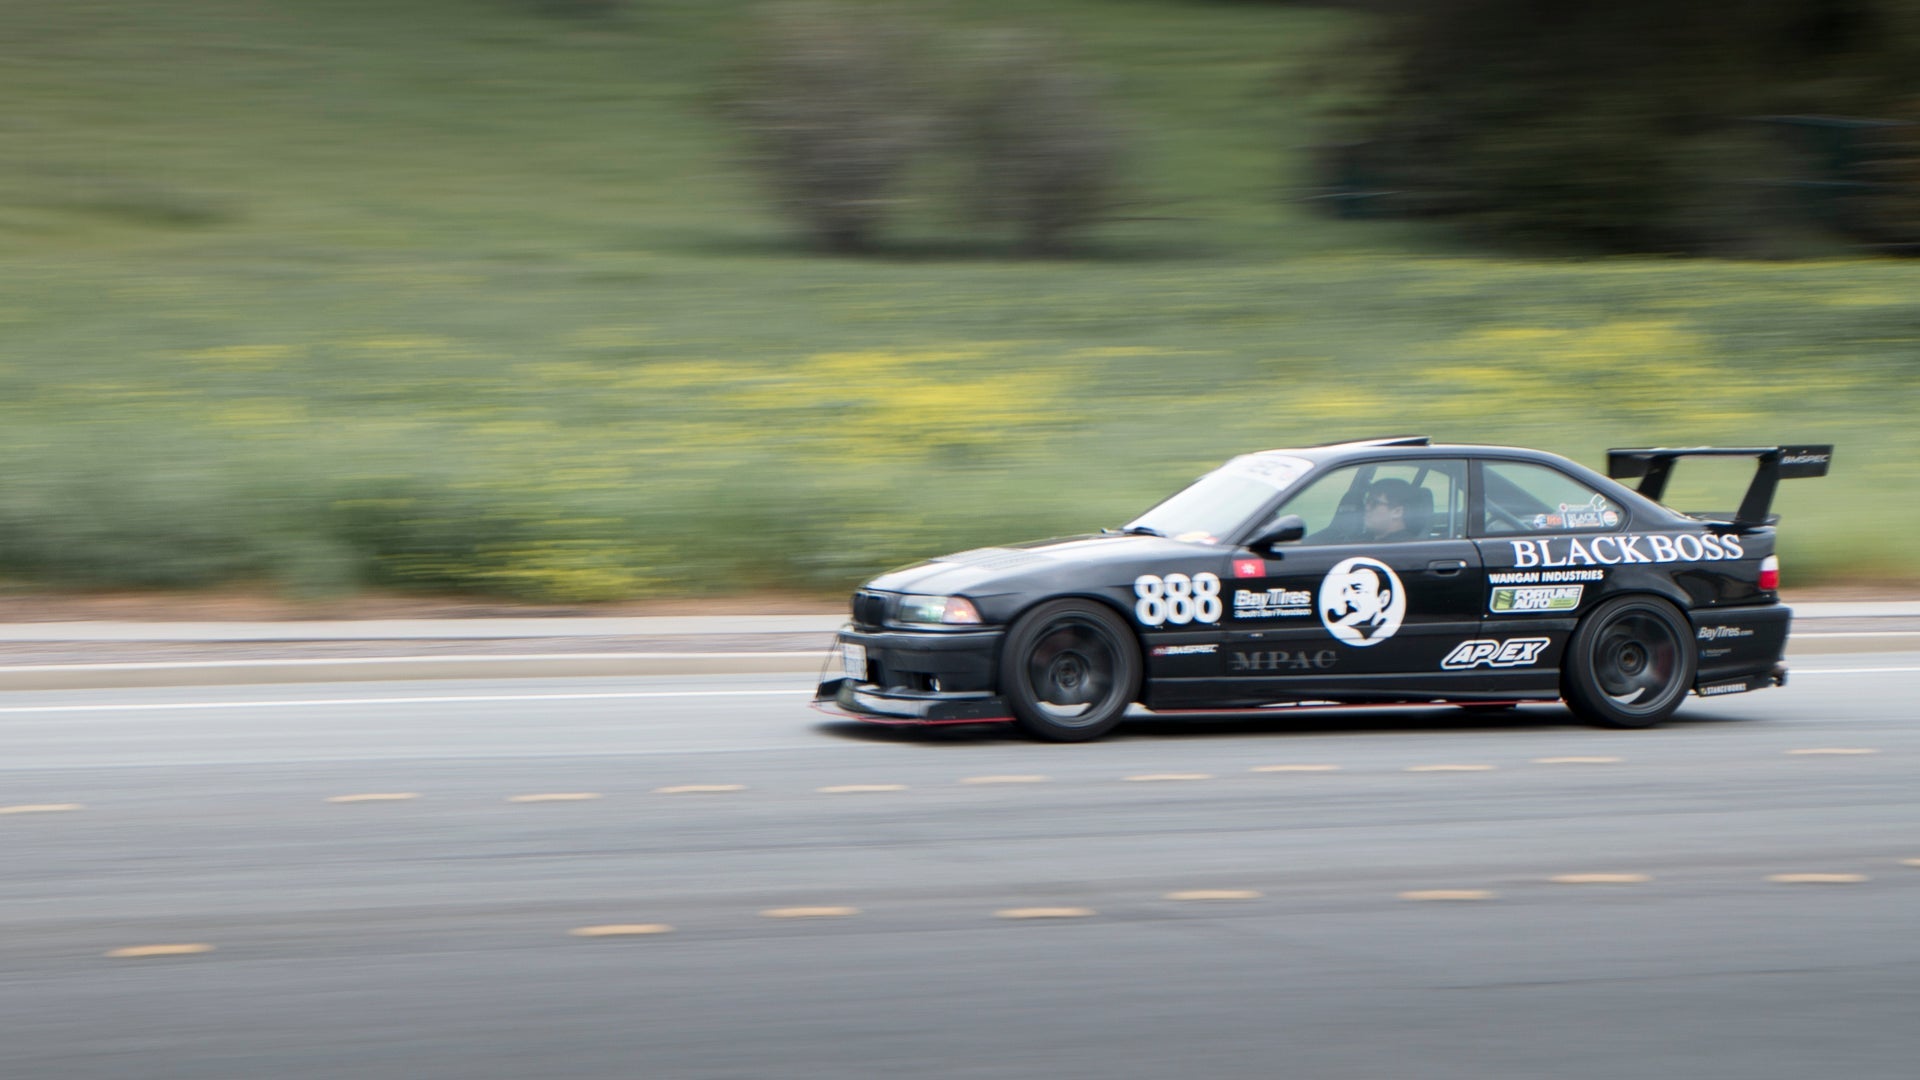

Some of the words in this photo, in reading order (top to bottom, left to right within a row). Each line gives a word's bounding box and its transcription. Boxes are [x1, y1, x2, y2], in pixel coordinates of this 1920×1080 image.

[1782, 455, 1829, 464] BMSPEC
[1510, 535, 1650, 568] BLACK
[1646, 533, 1745, 563] BOSS
[1488, 572, 1540, 584] WANGAN
[1541, 569, 1604, 583] INDUSTRIES
[1134, 572, 1223, 626] 888
[1233, 588, 1312, 608] BayTires
[1513, 599, 1551, 609] AUTO
[1514, 588, 1580, 600] FORTUNE
[1232, 650, 1337, 671] MPAC
[1446, 641, 1545, 666] APEX
